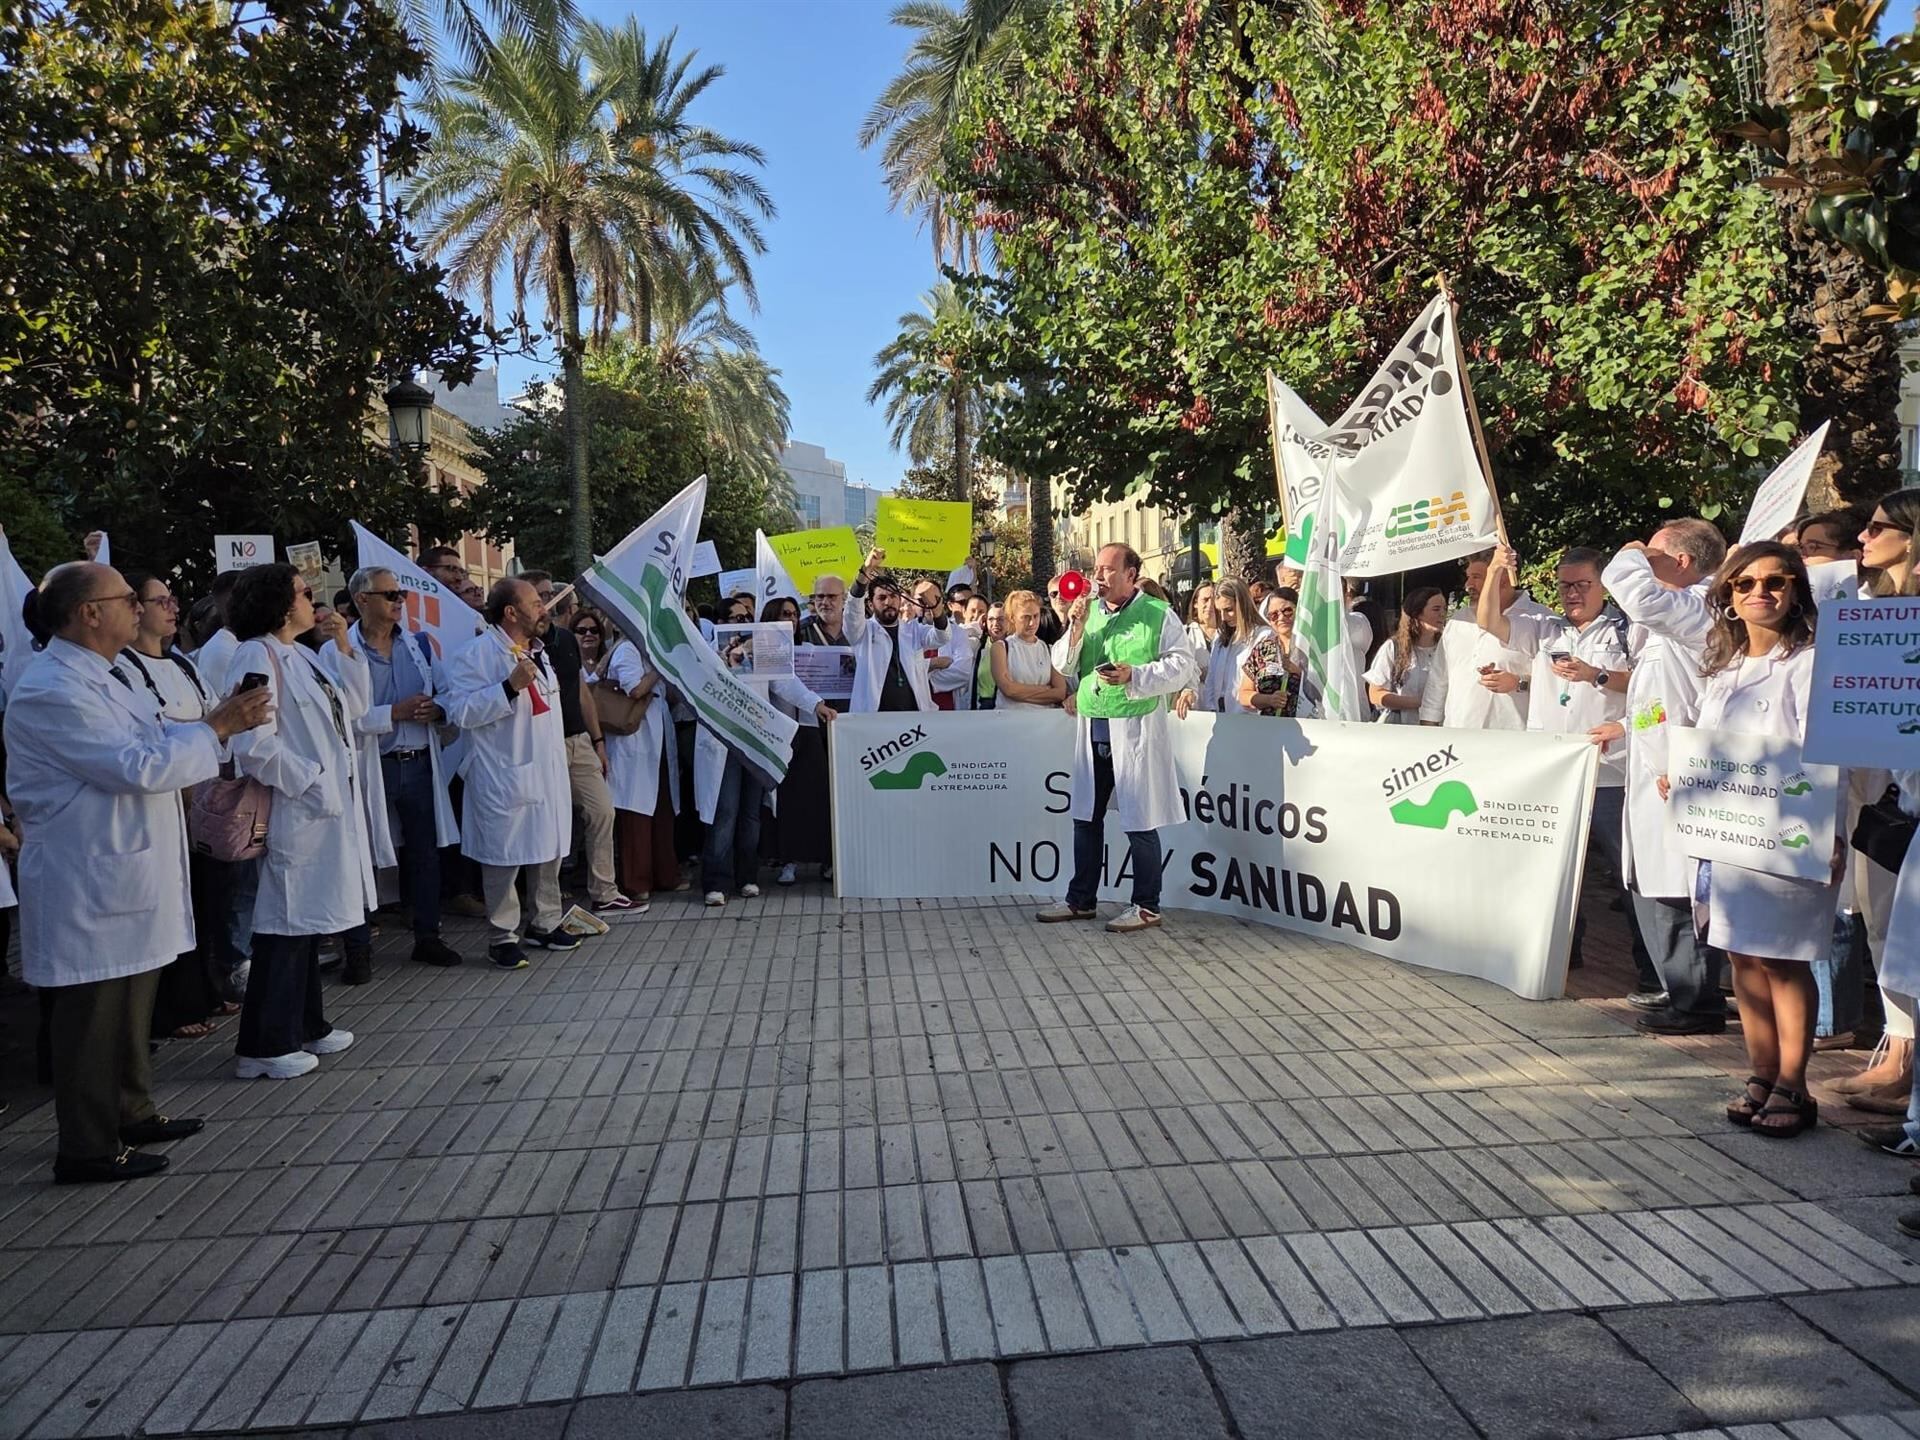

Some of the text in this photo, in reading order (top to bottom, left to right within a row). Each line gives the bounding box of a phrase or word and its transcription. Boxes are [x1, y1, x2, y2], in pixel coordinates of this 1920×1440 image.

[1385, 491, 1470, 538] CESM
[860, 723, 927, 771] simex
[950, 761, 1008, 769] SINDICATO
[1382, 744, 1459, 797] simex
[1689, 757, 1768, 777] SIN MÉDICOS
[930, 783, 1008, 792] EXTREMADURA
[1678, 775, 1778, 799] NO HAY SANIDAD
[1780, 770, 1806, 787] simex
[1483, 800, 1559, 814] SINDICATO
[1687, 804, 1766, 828] SIN MÉDICOS
[1479, 815, 1557, 830] MEDICO DE
[1778, 823, 1805, 839] simex
[1677, 823, 1776, 850] NO HAY SANIDAD
[990, 840, 1060, 882] NO
[1188, 851, 1401, 942] SANIDAD
